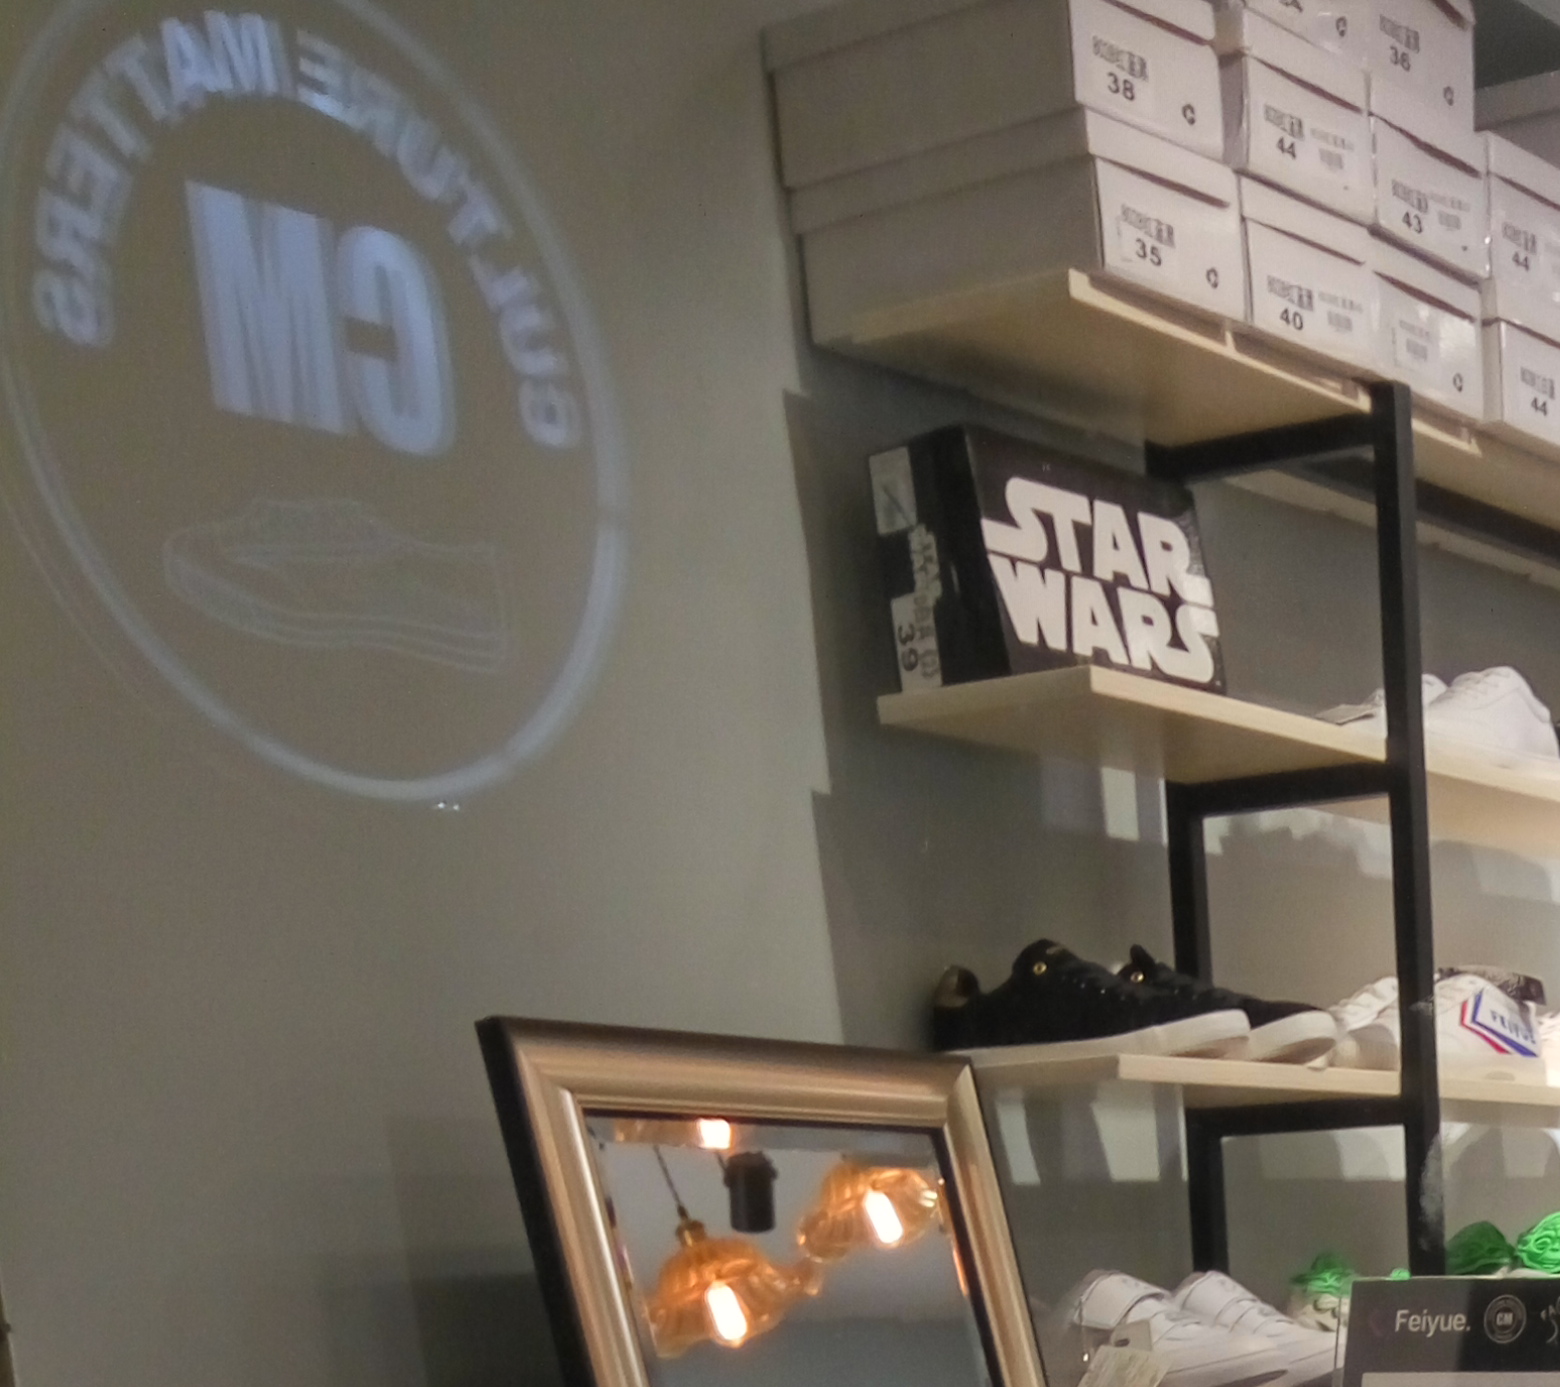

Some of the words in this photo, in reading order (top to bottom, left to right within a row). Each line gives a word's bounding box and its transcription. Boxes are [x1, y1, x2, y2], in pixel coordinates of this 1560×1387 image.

[1106, 71, 1136, 102] 38
[1275, 135, 1297, 161] 44
[1401, 210, 1423, 235] 43
[1134, 237, 1163, 268] 35
[1279, 306, 1304, 332] 40
[1530, 397, 1549, 417] 44
[980, 476, 1214, 607] STAR
[987, 553, 1220, 684] WARS
[1394, 1309, 1471, 1338] Feiyue.
